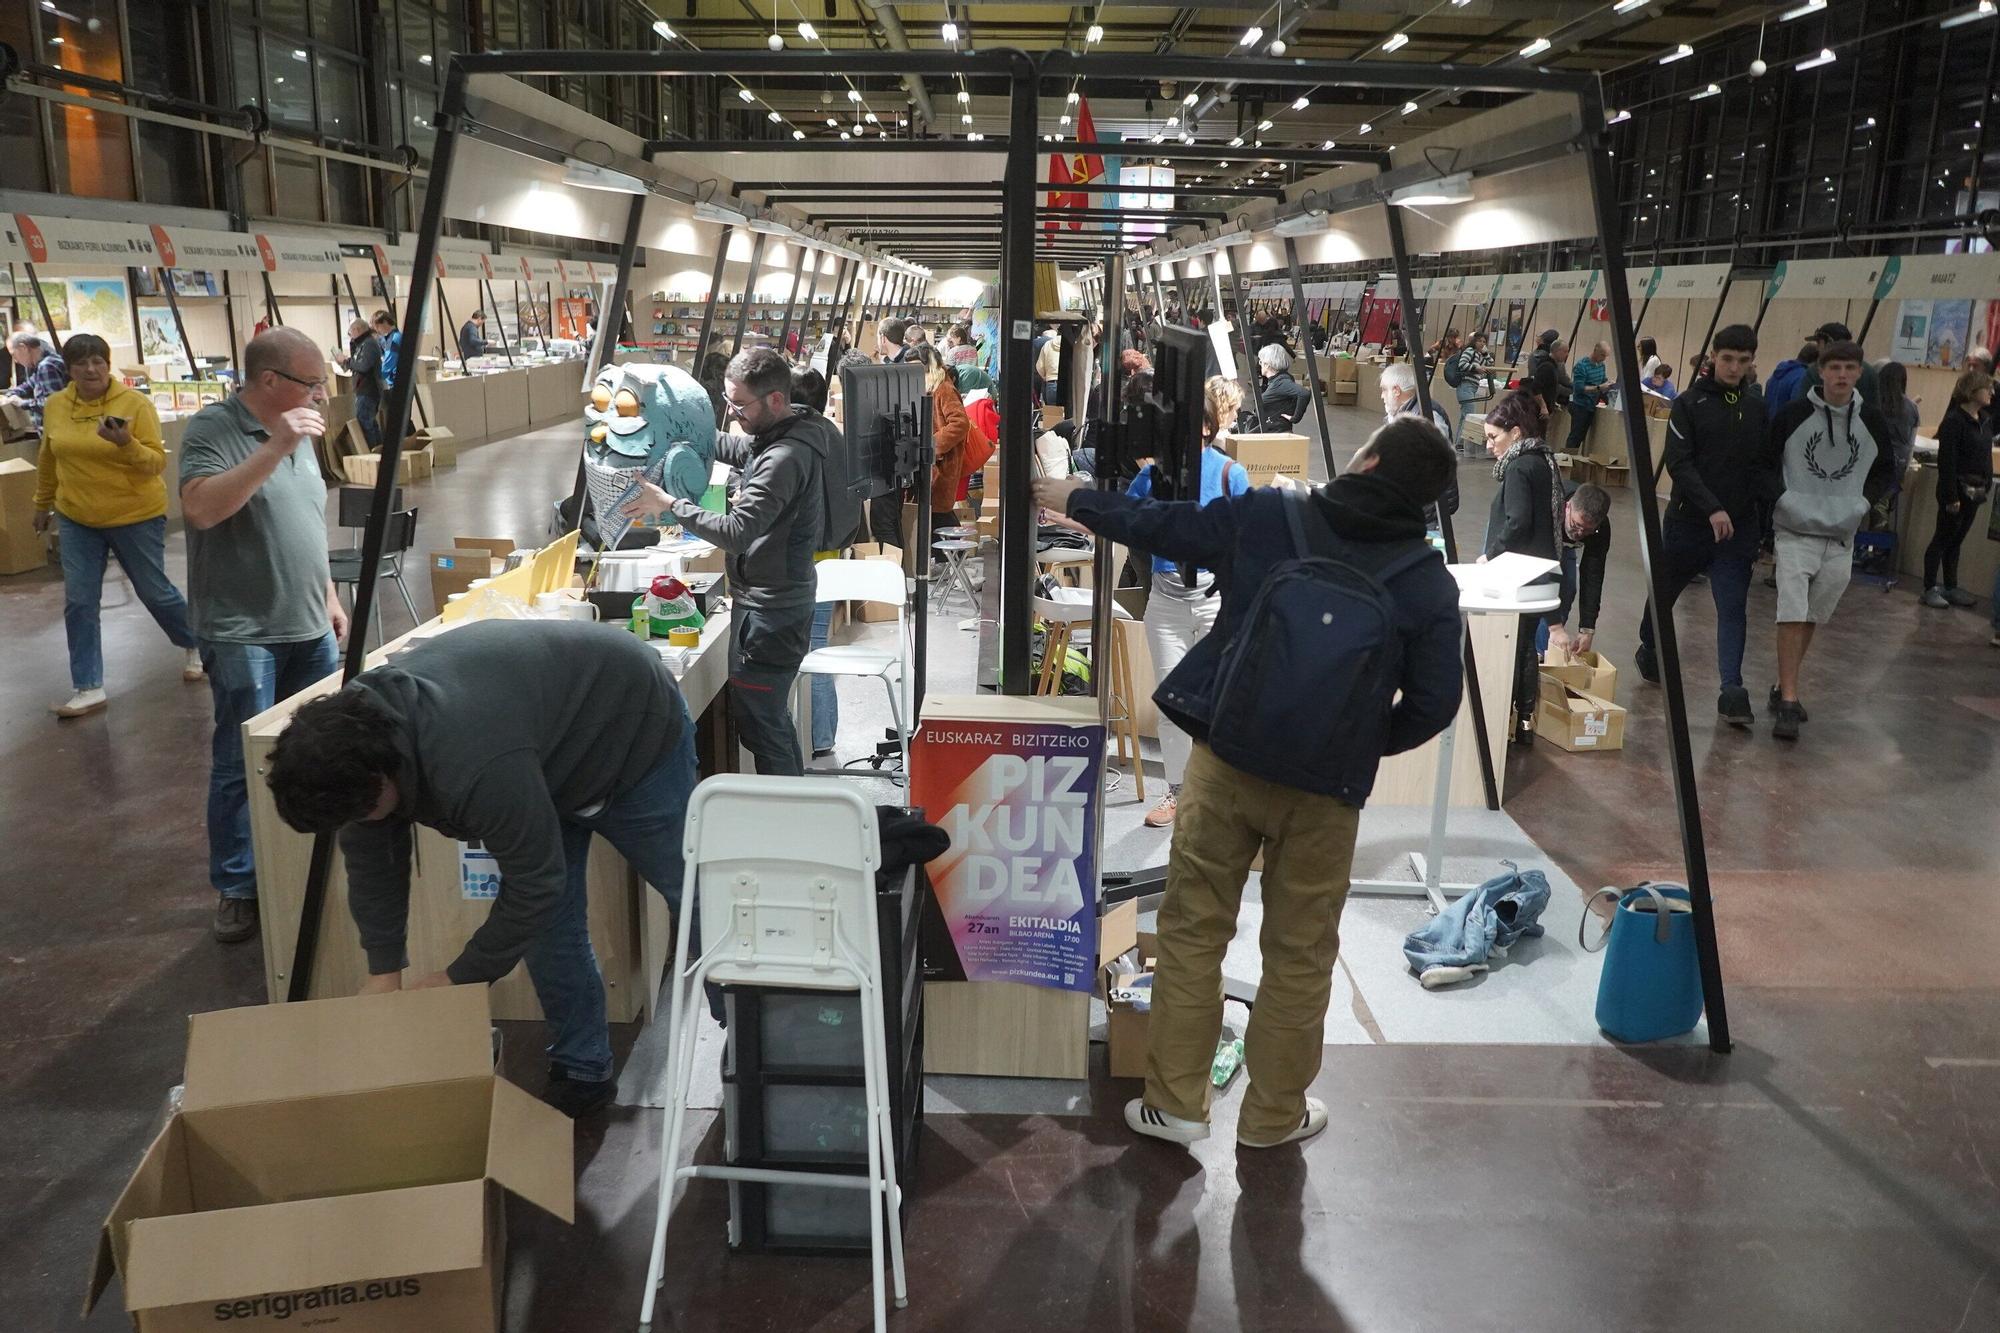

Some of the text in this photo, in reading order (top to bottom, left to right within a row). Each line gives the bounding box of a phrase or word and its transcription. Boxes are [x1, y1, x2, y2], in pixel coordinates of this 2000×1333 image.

[926, 731, 1090, 748] EUSKARAZ BIZITZEKO
[991, 754, 1089, 804] PIZ
[955, 803, 1085, 853] KUN
[967, 855, 1084, 905] DEA
[967, 922, 1000, 935] 27an
[1008, 915, 1082, 934] EKITALDIA
[1009, 930, 1081, 944] BILBAO ARENA 17:00
[1009, 968, 1060, 981] pizkundea.eus
[214, 1278, 421, 1321] serigrafia.eus
